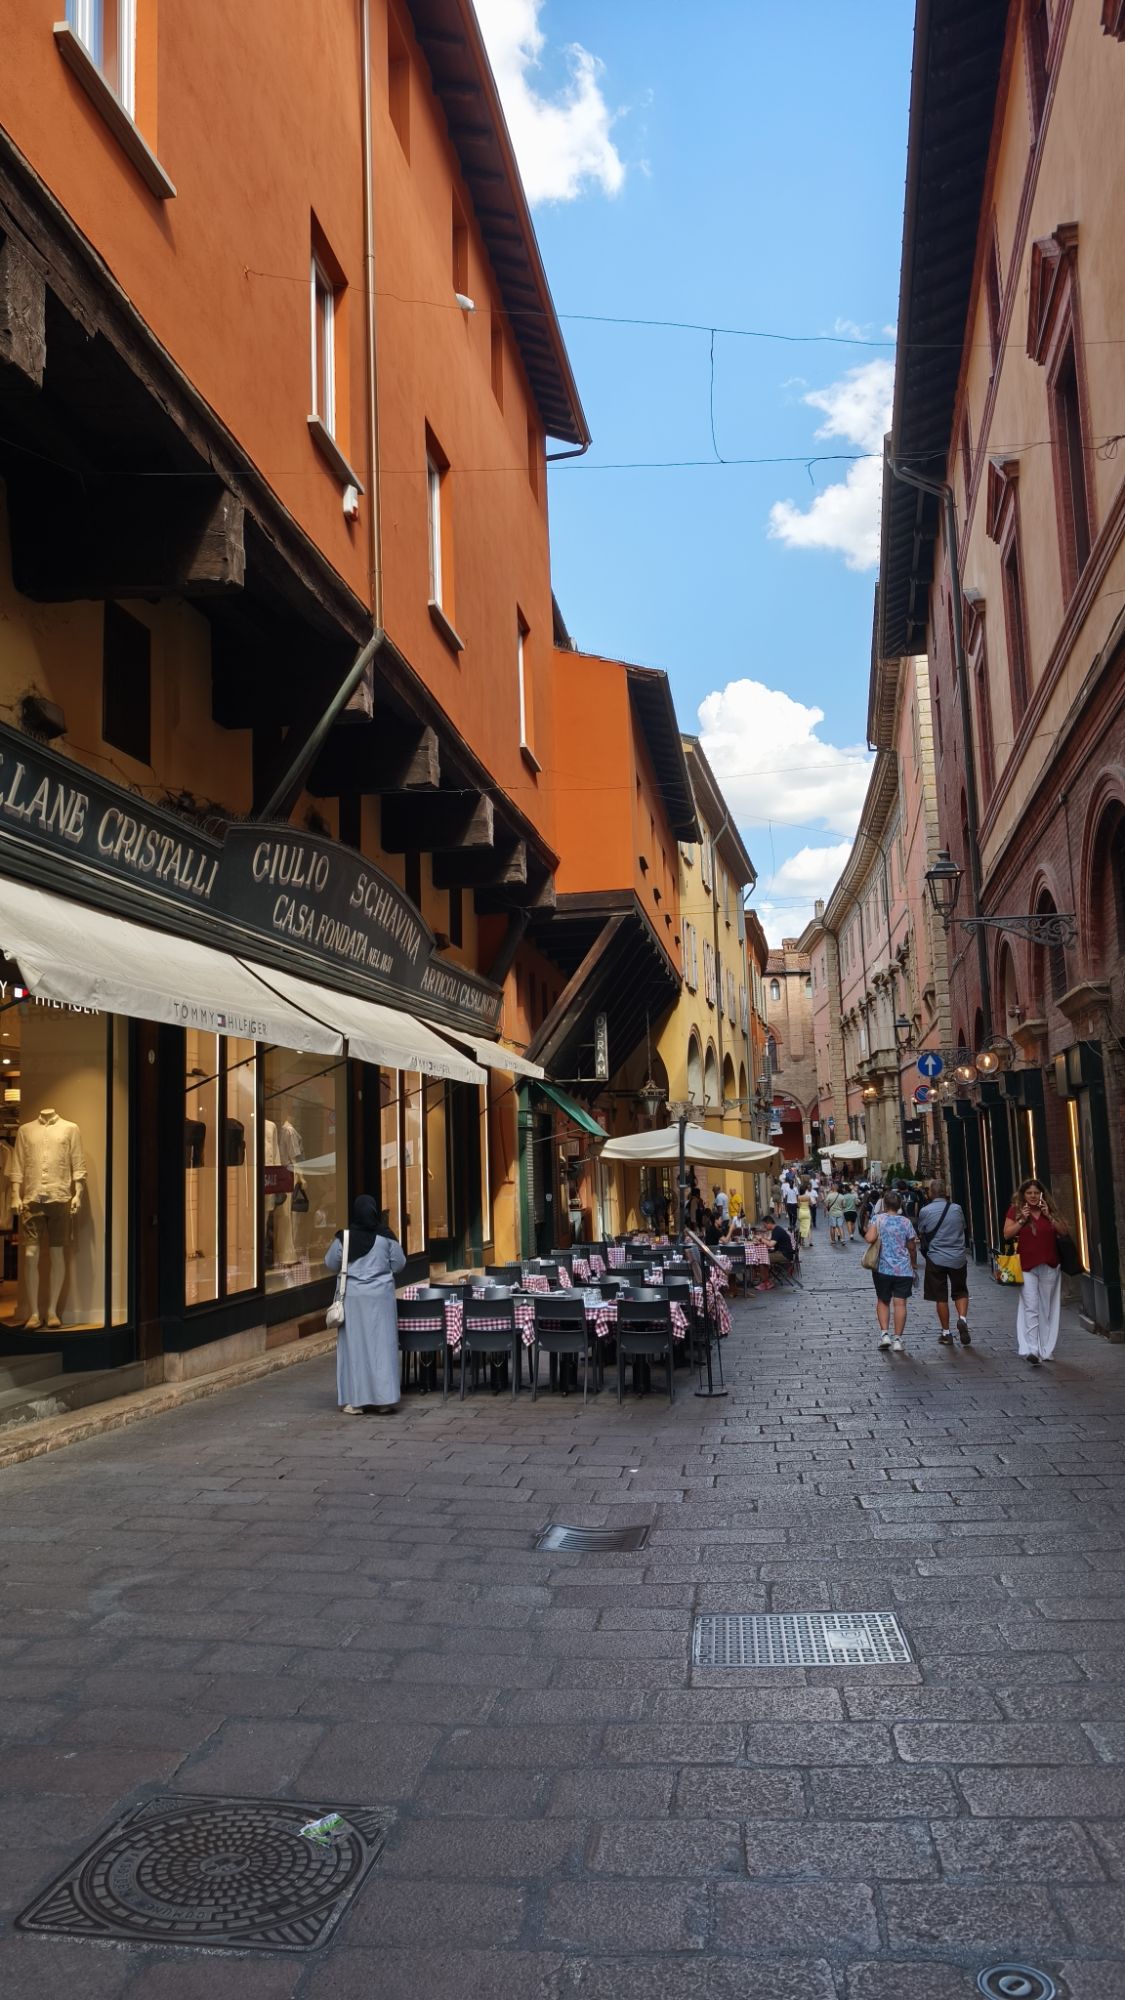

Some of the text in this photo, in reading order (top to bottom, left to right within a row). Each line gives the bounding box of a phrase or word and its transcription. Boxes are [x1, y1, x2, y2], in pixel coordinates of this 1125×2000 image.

[97, 807, 219, 898] CRISTALLI
[252, 842, 422, 965] GIULIO SCHIAVINA
[272, 894, 315, 944] CASA
[315, 914, 369, 965] FONDATA
[367, 947, 381, 968] NEL
[420, 966, 460, 1003] ARTICOLI
[173, 1003, 268, 1036] TOMMY HILFIGER
[596, 1016, 606, 1075] OSRAM
